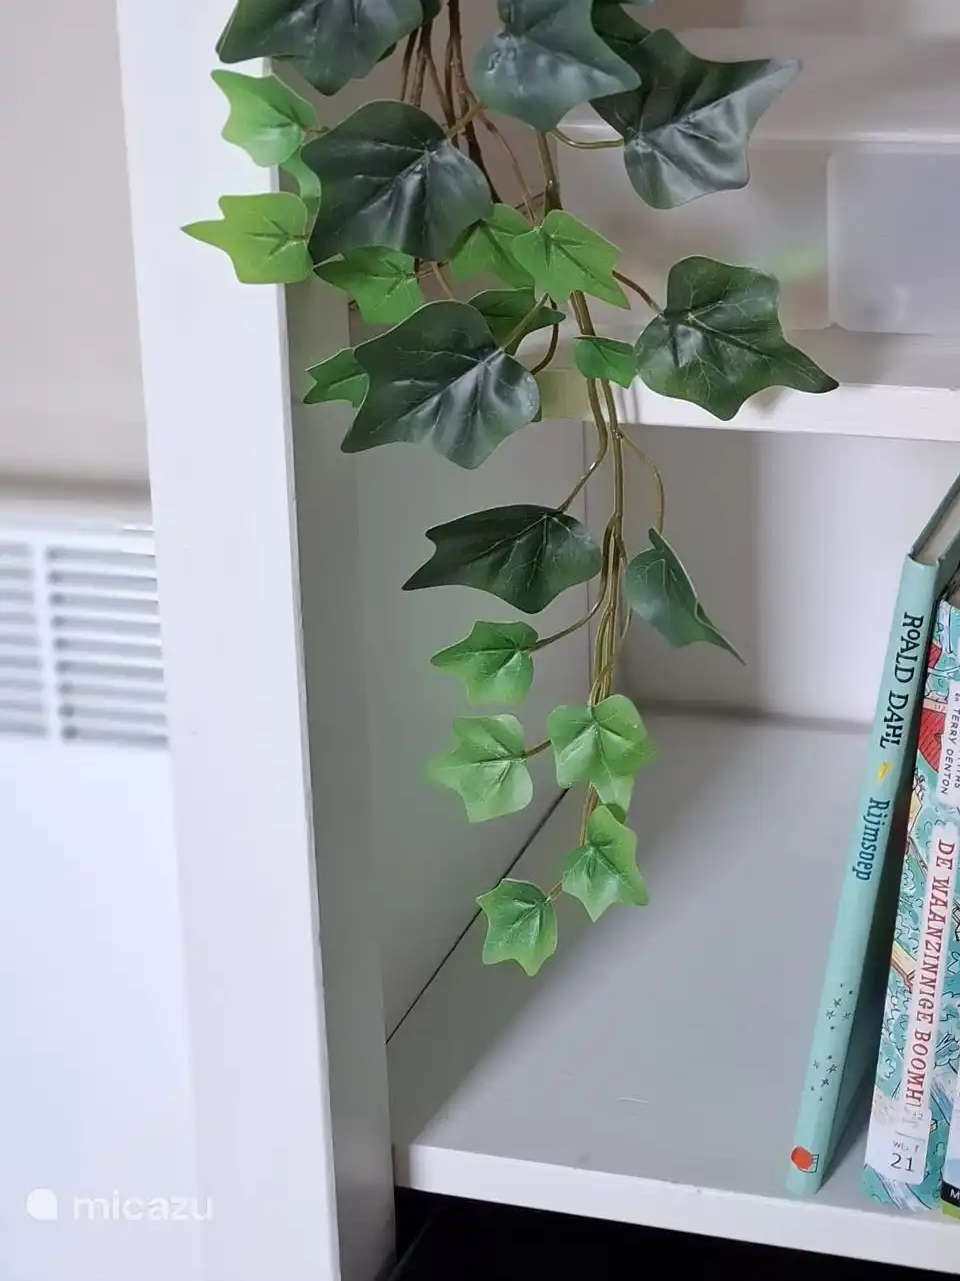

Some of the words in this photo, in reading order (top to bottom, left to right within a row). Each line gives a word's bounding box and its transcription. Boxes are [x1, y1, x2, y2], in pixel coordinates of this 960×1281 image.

[893, 611, 924, 684] ROALD
[879, 690, 909, 749] DAHL
[948, 708, 960, 745] TERRY
[940, 748, 954, 795] DENTON
[852, 797, 890, 882] Rijmsoep
[935, 839, 955, 870] DE
[916, 875, 950, 1024] WAANZINNIGE
[902, 1028, 931, 1126] BOOMH
[890, 1152, 915, 1173] 21
